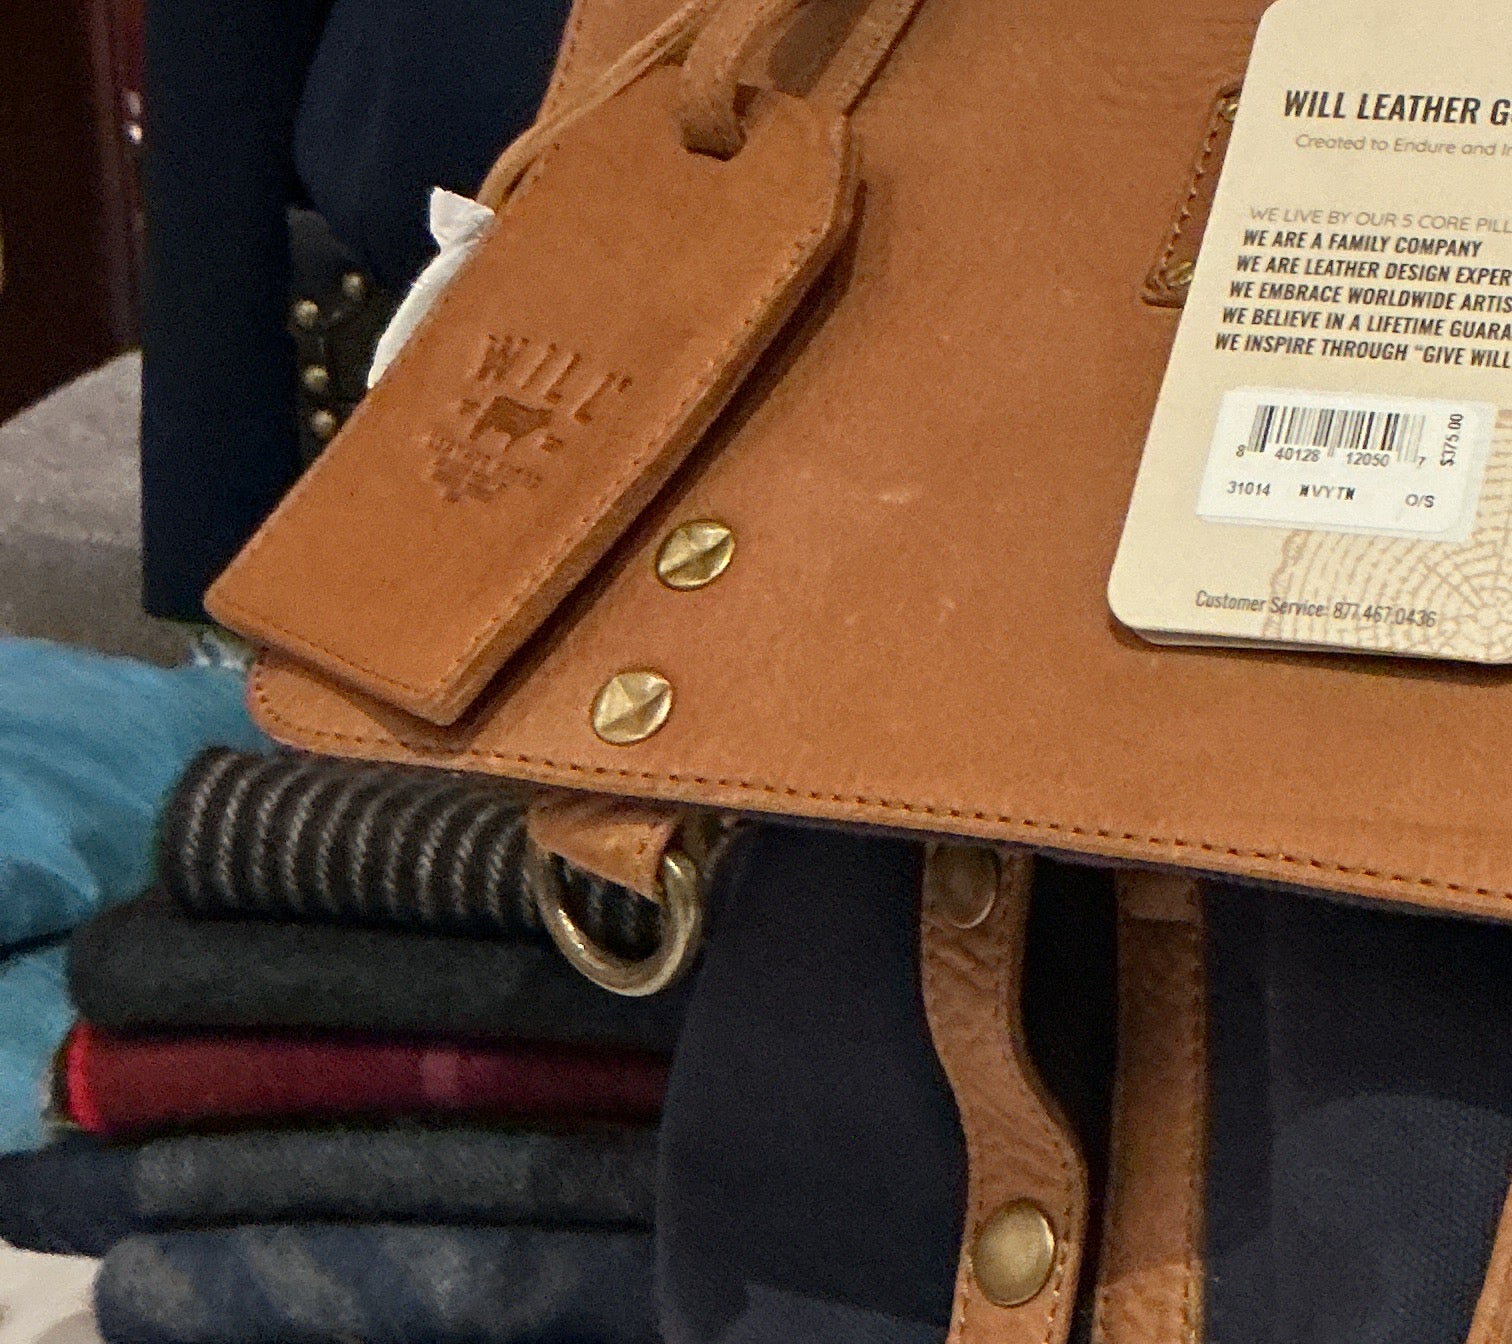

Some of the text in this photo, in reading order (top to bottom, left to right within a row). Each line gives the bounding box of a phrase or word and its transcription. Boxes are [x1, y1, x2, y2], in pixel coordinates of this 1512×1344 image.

[1284, 90, 1346, 119] WILL
[1357, 93, 1481, 124] LEATHER
[1296, 133, 1366, 150] Created
[1370, 138, 1389, 151] to
[1393, 138, 1456, 154] Endure
[1461, 142, 1496, 156] and
[1250, 207, 1277, 221] WE
[1284, 209, 1323, 225] LIVE
[1328, 211, 1352, 225] BY
[1356, 212, 1397, 227] OUR
[1402, 214, 1412, 228] 5
[1418, 215, 1470, 231] CORE
[1243, 229, 1483, 258] WE ARE A FAMILY COMPANY
[1237, 255, 1263, 272] WE
[1265, 257, 1299, 274] ARE
[1304, 259, 1379, 279] LEATHER
[1384, 263, 1450, 282] DESIGN
[1230, 281, 1256, 298] WE
[1259, 283, 1343, 303] EMBRACE
[1348, 287, 1457, 310] WORLDWIDE
[1223, 306, 1249, 325] WE
[1251, 308, 1321, 329] BELIEVE
[1325, 312, 1345, 330] IN
[1349, 314, 1361, 331] A
[1367, 315, 1444, 336] LIFETIME
[1215, 333, 1240, 350] WE
[1245, 334, 1316, 355] INSPIRE
[1321, 339, 1408, 361] THROUGH
[1414, 344, 1466, 366] “GIVE
[1440, 413, 1464, 467] $375.00
[1236, 445, 1426, 468] 8 40128 12050 7
[1227, 481, 1271, 496] 31014
[1405, 494, 1434, 508] O/S
[1195, 590, 1437, 628] Customer Service: 877.467.0436
